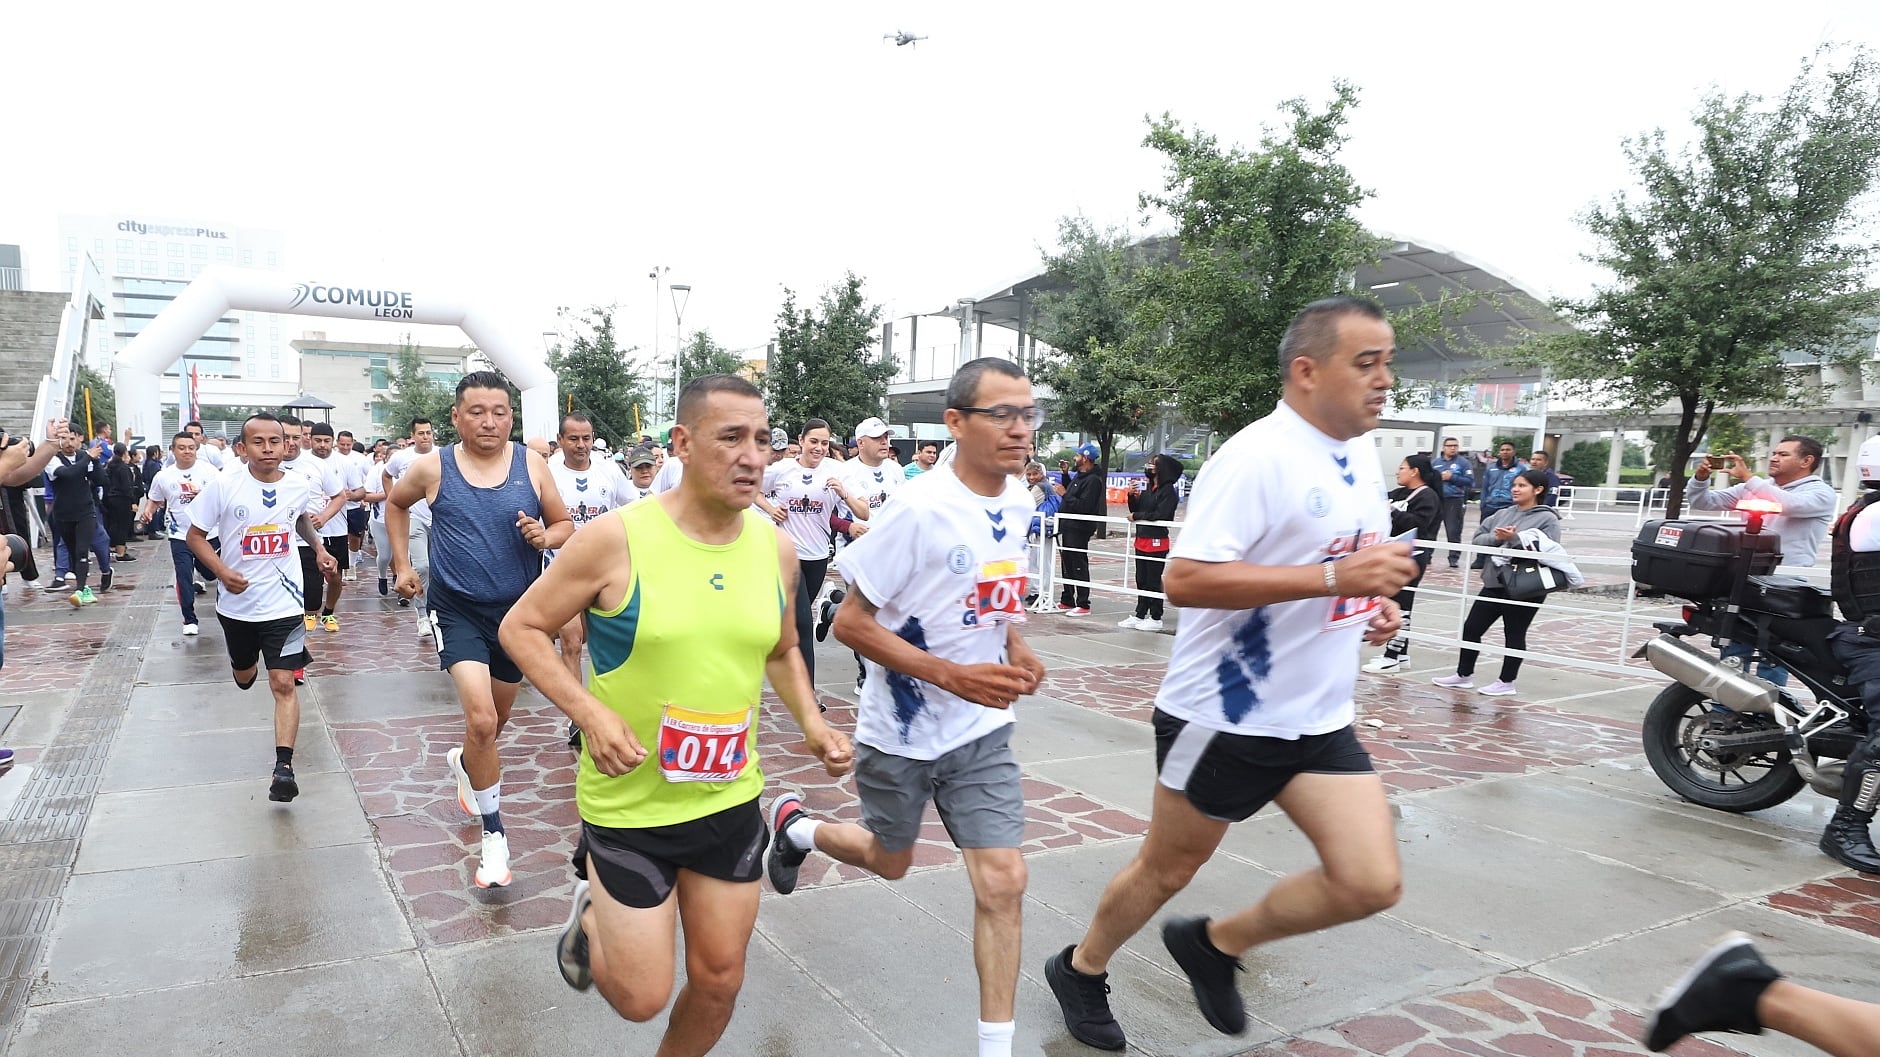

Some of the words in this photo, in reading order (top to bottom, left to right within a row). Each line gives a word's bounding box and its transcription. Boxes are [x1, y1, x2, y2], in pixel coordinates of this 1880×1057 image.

[312, 286, 413, 309] COMUDE
[374, 306, 413, 319] LEÓN
[250, 535, 283, 554] 012
[677, 735, 739, 771] 014
